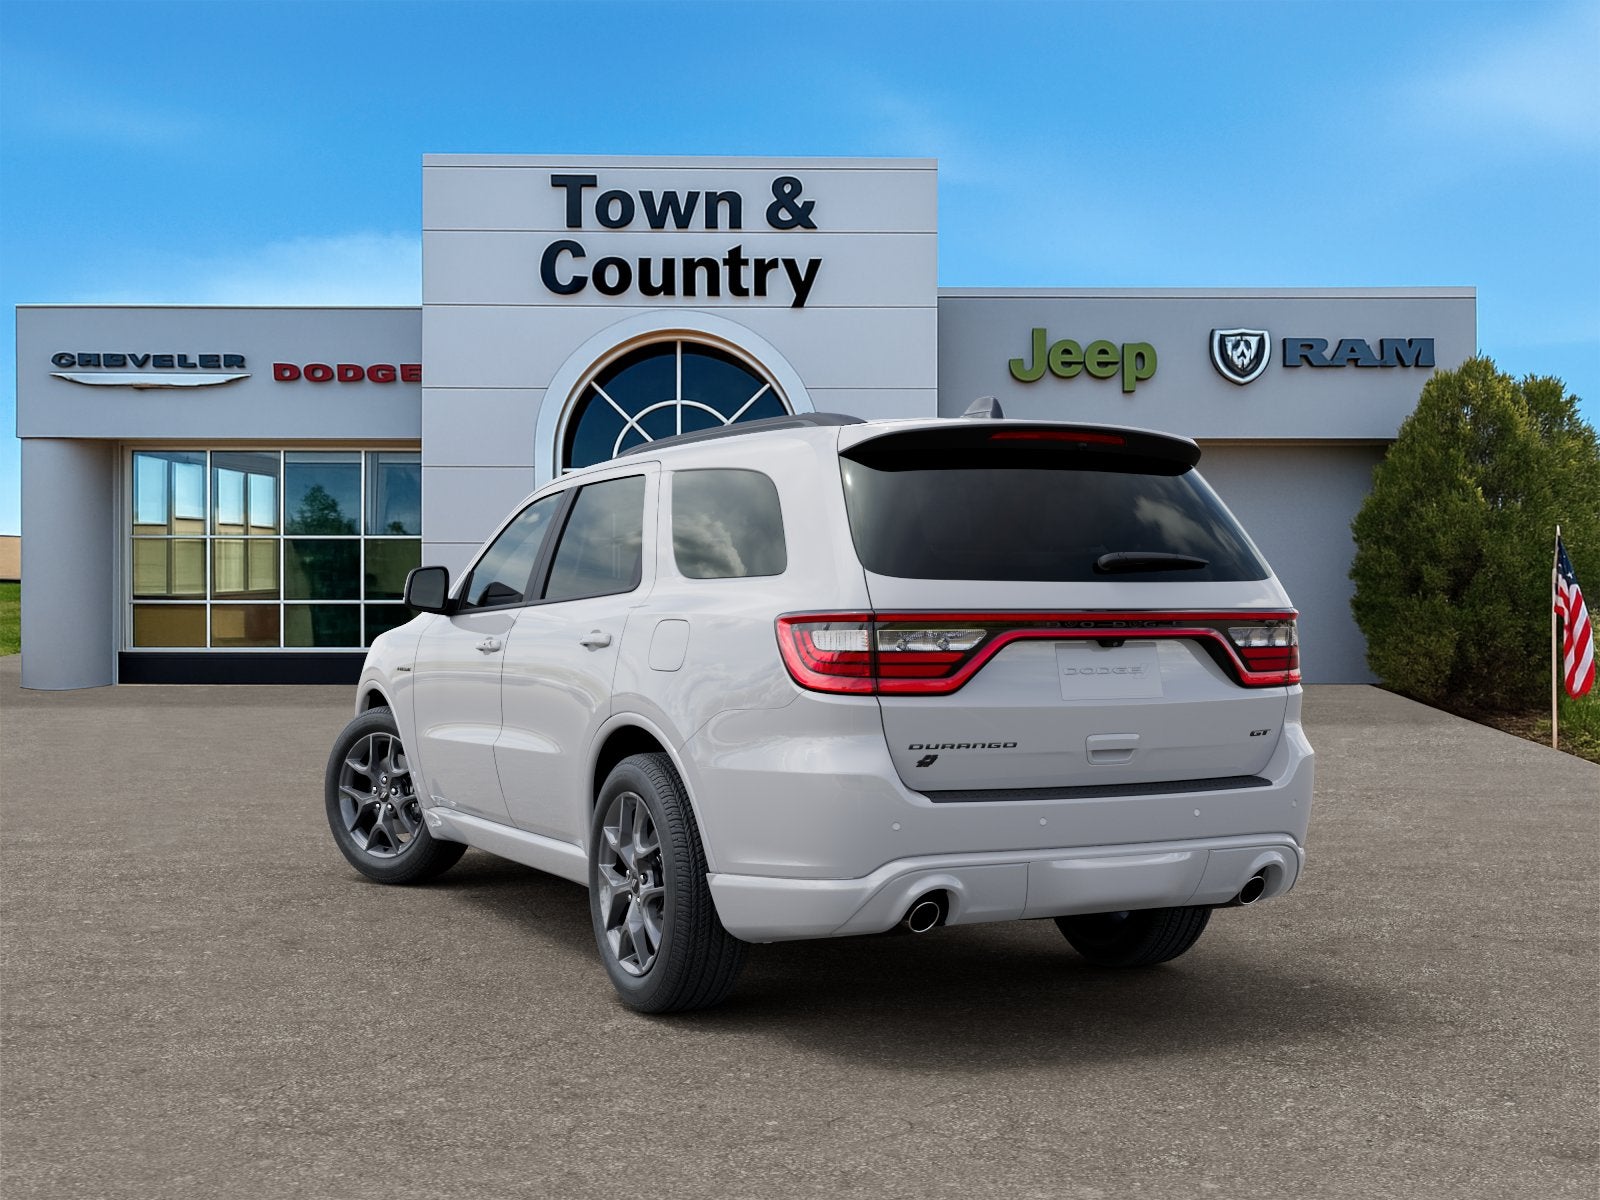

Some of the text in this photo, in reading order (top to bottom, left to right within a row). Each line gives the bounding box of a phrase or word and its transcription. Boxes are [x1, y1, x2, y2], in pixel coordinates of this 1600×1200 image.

[550, 174, 818, 229] Town &
[540, 239, 822, 308] Country
[1009, 328, 1157, 392] Jeep
[1282, 337, 1435, 367] RAM
[273, 363, 422, 383] DODGE
[907, 742, 1018, 750] DURANGO
[1249, 728, 1272, 737] GT
